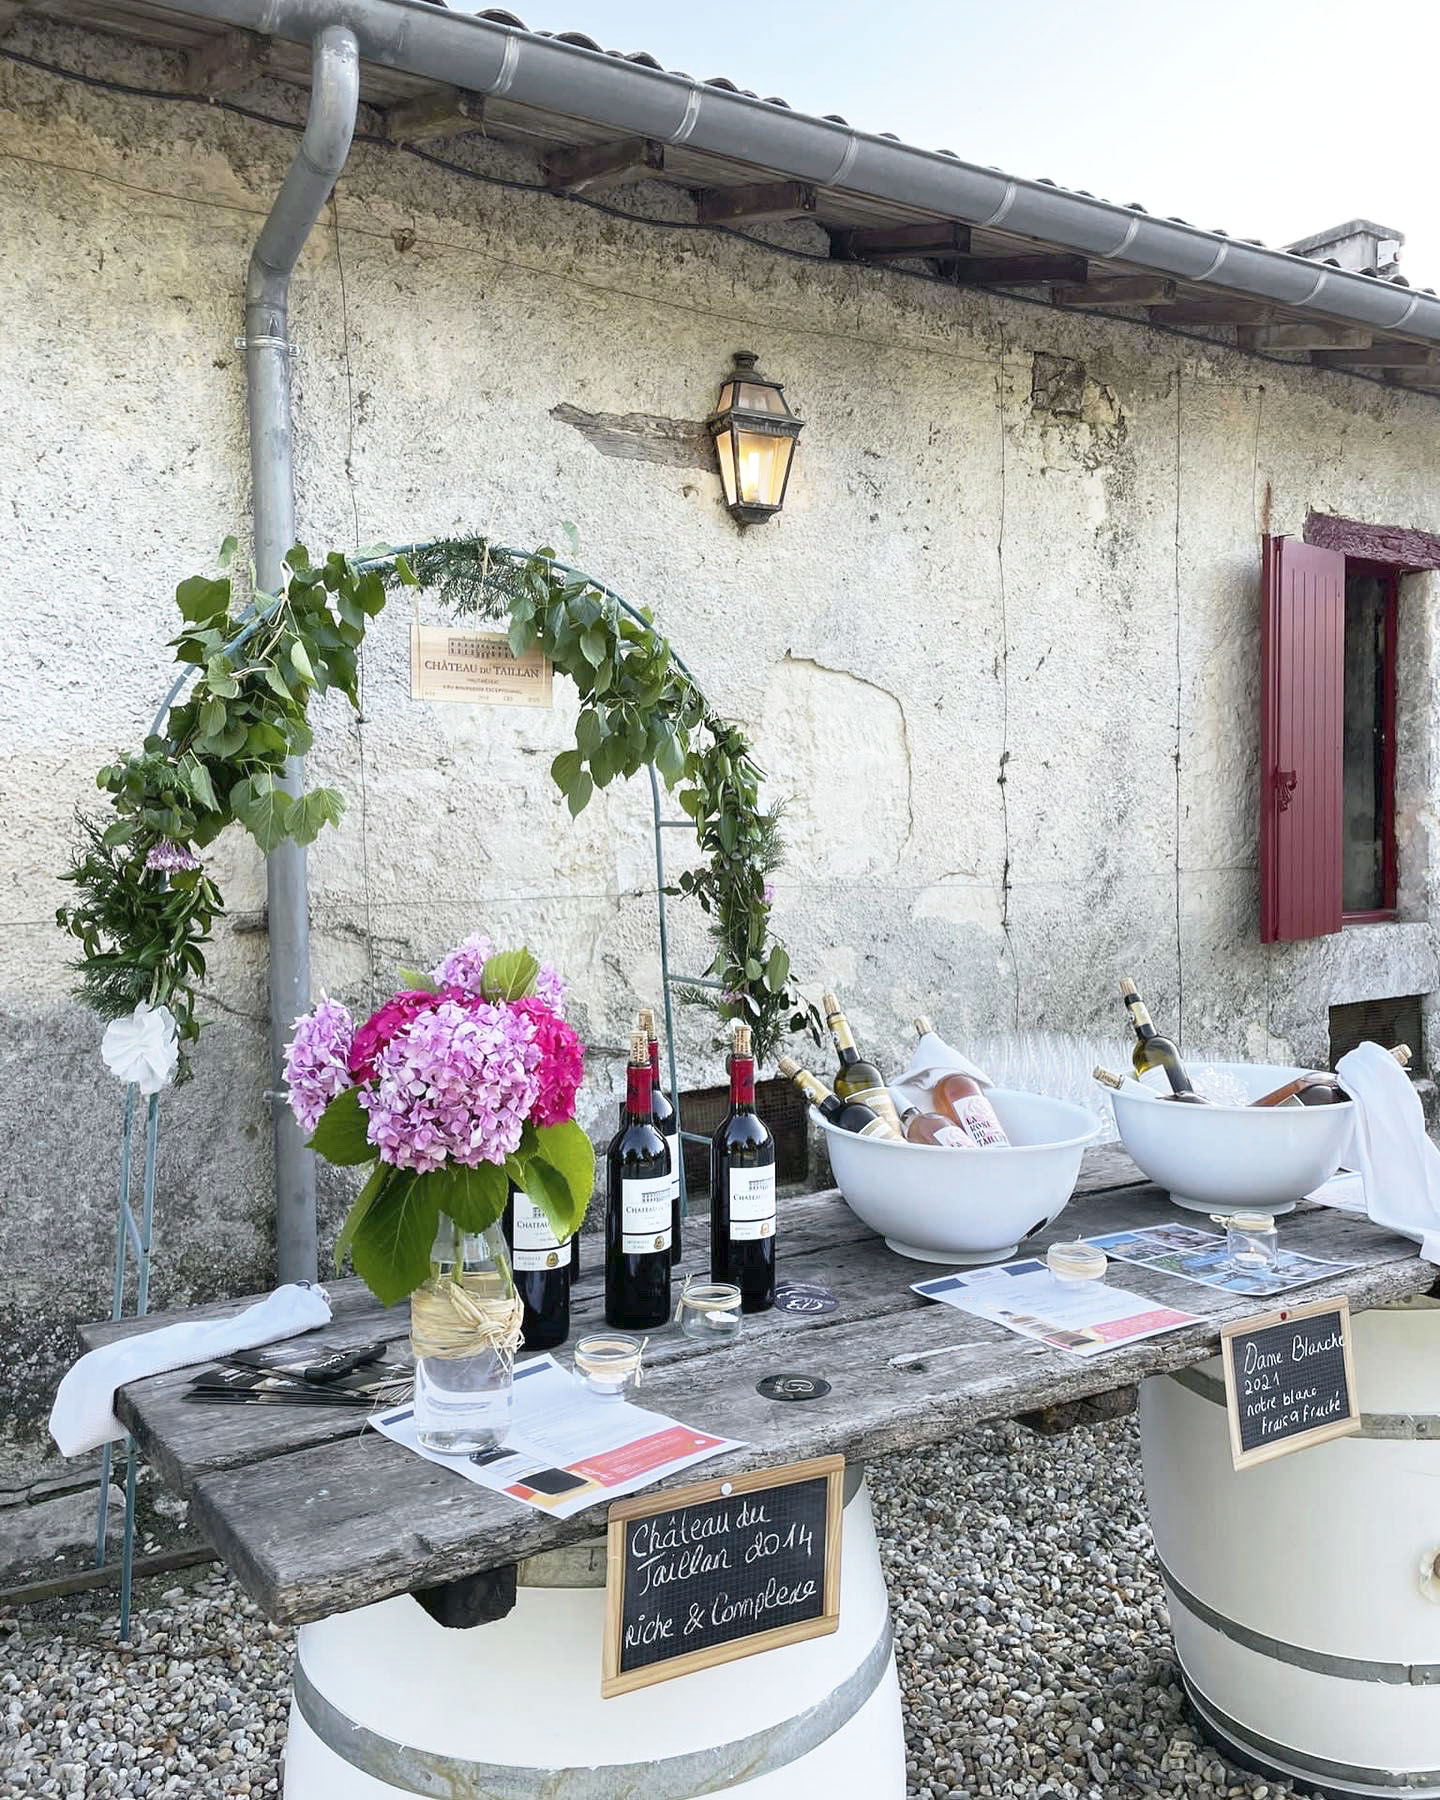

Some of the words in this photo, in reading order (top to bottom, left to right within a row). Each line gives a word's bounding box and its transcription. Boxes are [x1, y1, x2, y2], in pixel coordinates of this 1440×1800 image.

[424, 660, 477, 674] CHÂTEAU
[493, 665, 539, 678] TAILLAN
[1244, 1342, 1283, 1375] Dame
[1245, 1372, 1280, 1395] 2021
[1247, 1396, 1276, 1416] notre
[1283, 1388, 1316, 1406] blanc
[1262, 1416, 1288, 1435] frais
[632, 1511, 730, 1557] Château
[736, 1501, 772, 1529] du
[637, 1545, 731, 1596] Taillan
[745, 1523, 812, 1563] 2014
[683, 1603, 705, 1635] &
